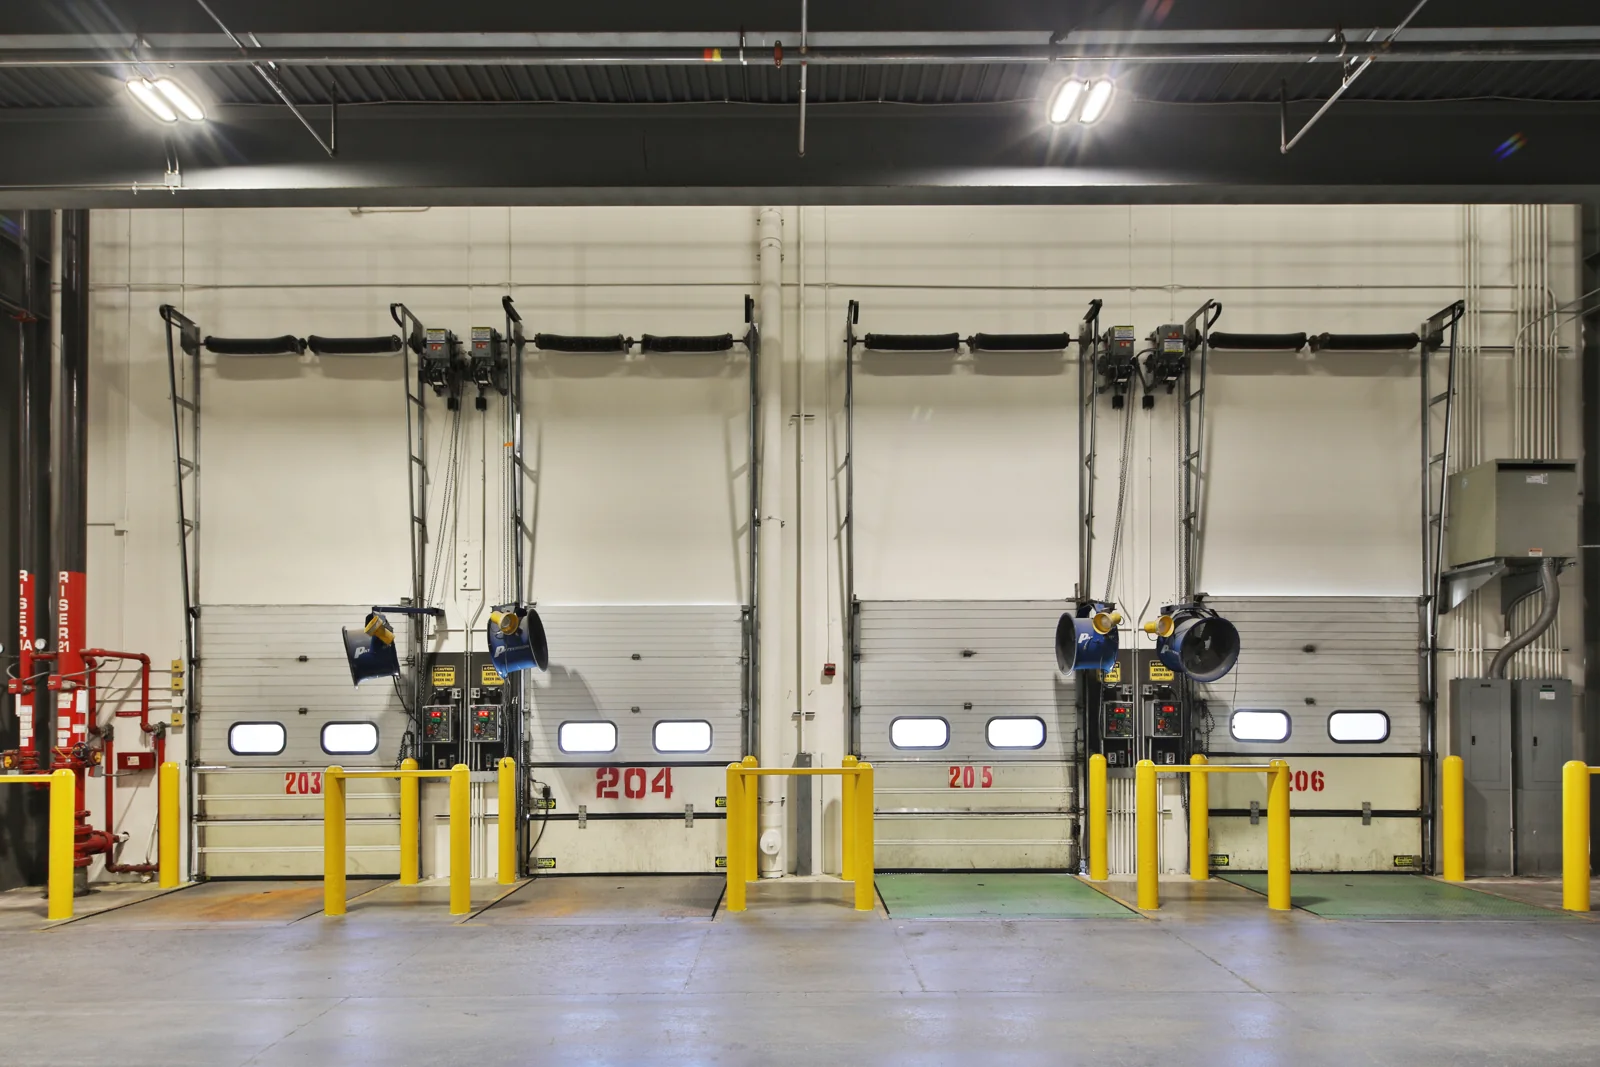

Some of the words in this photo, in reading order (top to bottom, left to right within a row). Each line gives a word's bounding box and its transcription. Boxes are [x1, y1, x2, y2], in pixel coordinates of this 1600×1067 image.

[19, 570, 28, 637] RISER
[59, 571, 69, 639] RISER
[58, 641, 70, 653] 21
[285, 772, 321, 794] 203
[596, 767, 673, 799] 204
[949, 766, 993, 788] 205
